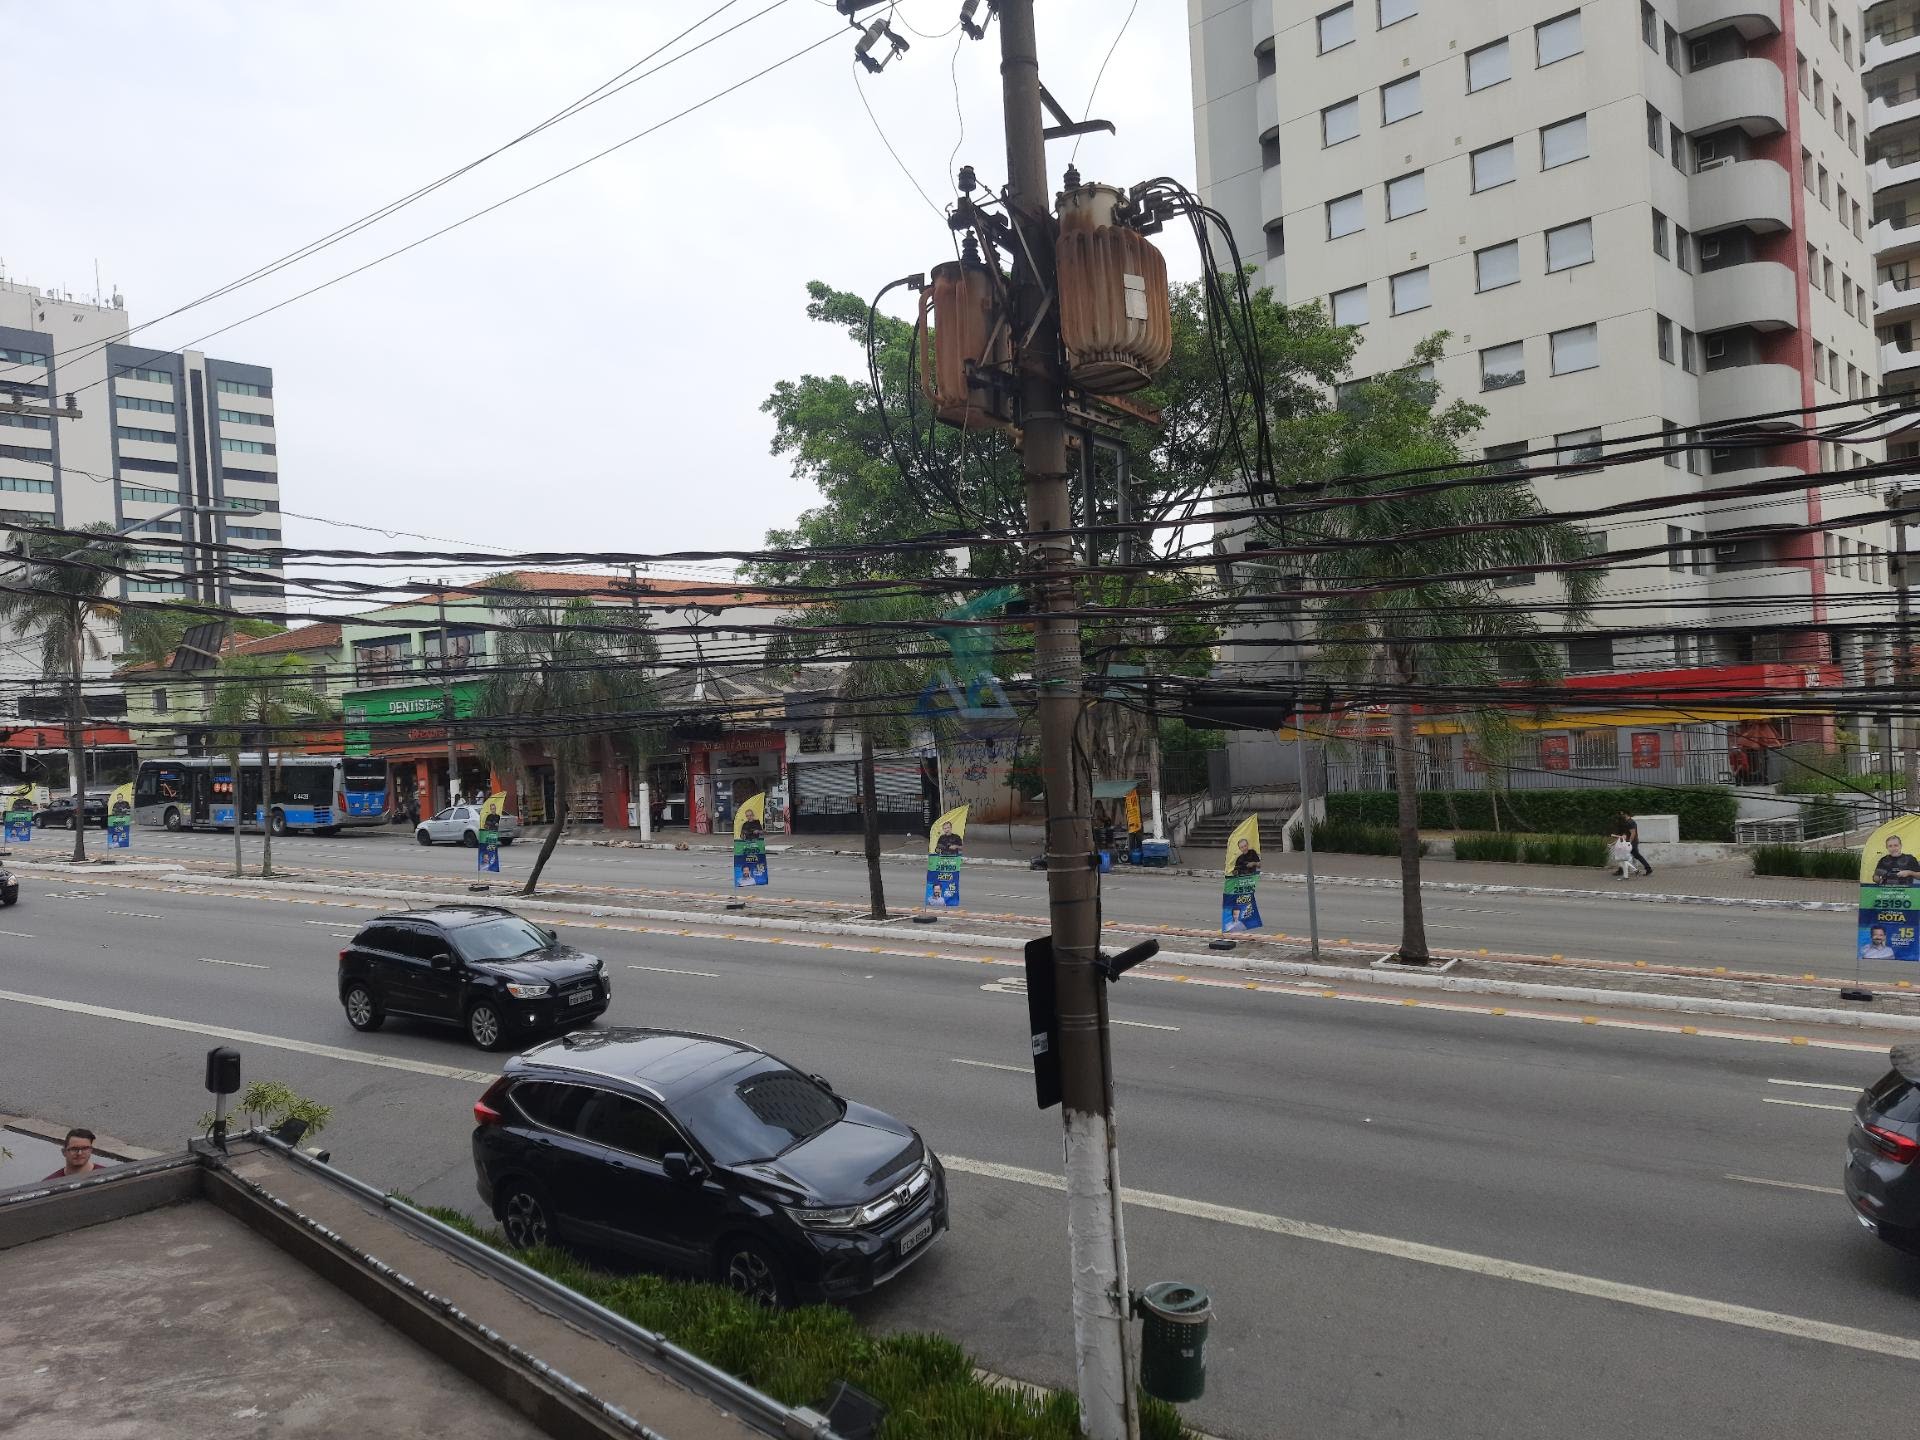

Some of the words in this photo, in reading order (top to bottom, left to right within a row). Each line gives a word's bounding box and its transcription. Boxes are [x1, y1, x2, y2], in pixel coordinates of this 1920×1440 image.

[1874, 900, 1912, 909] 25190
[1877, 913, 1906, 922] ROTA
[1898, 927, 1915, 938] 15
